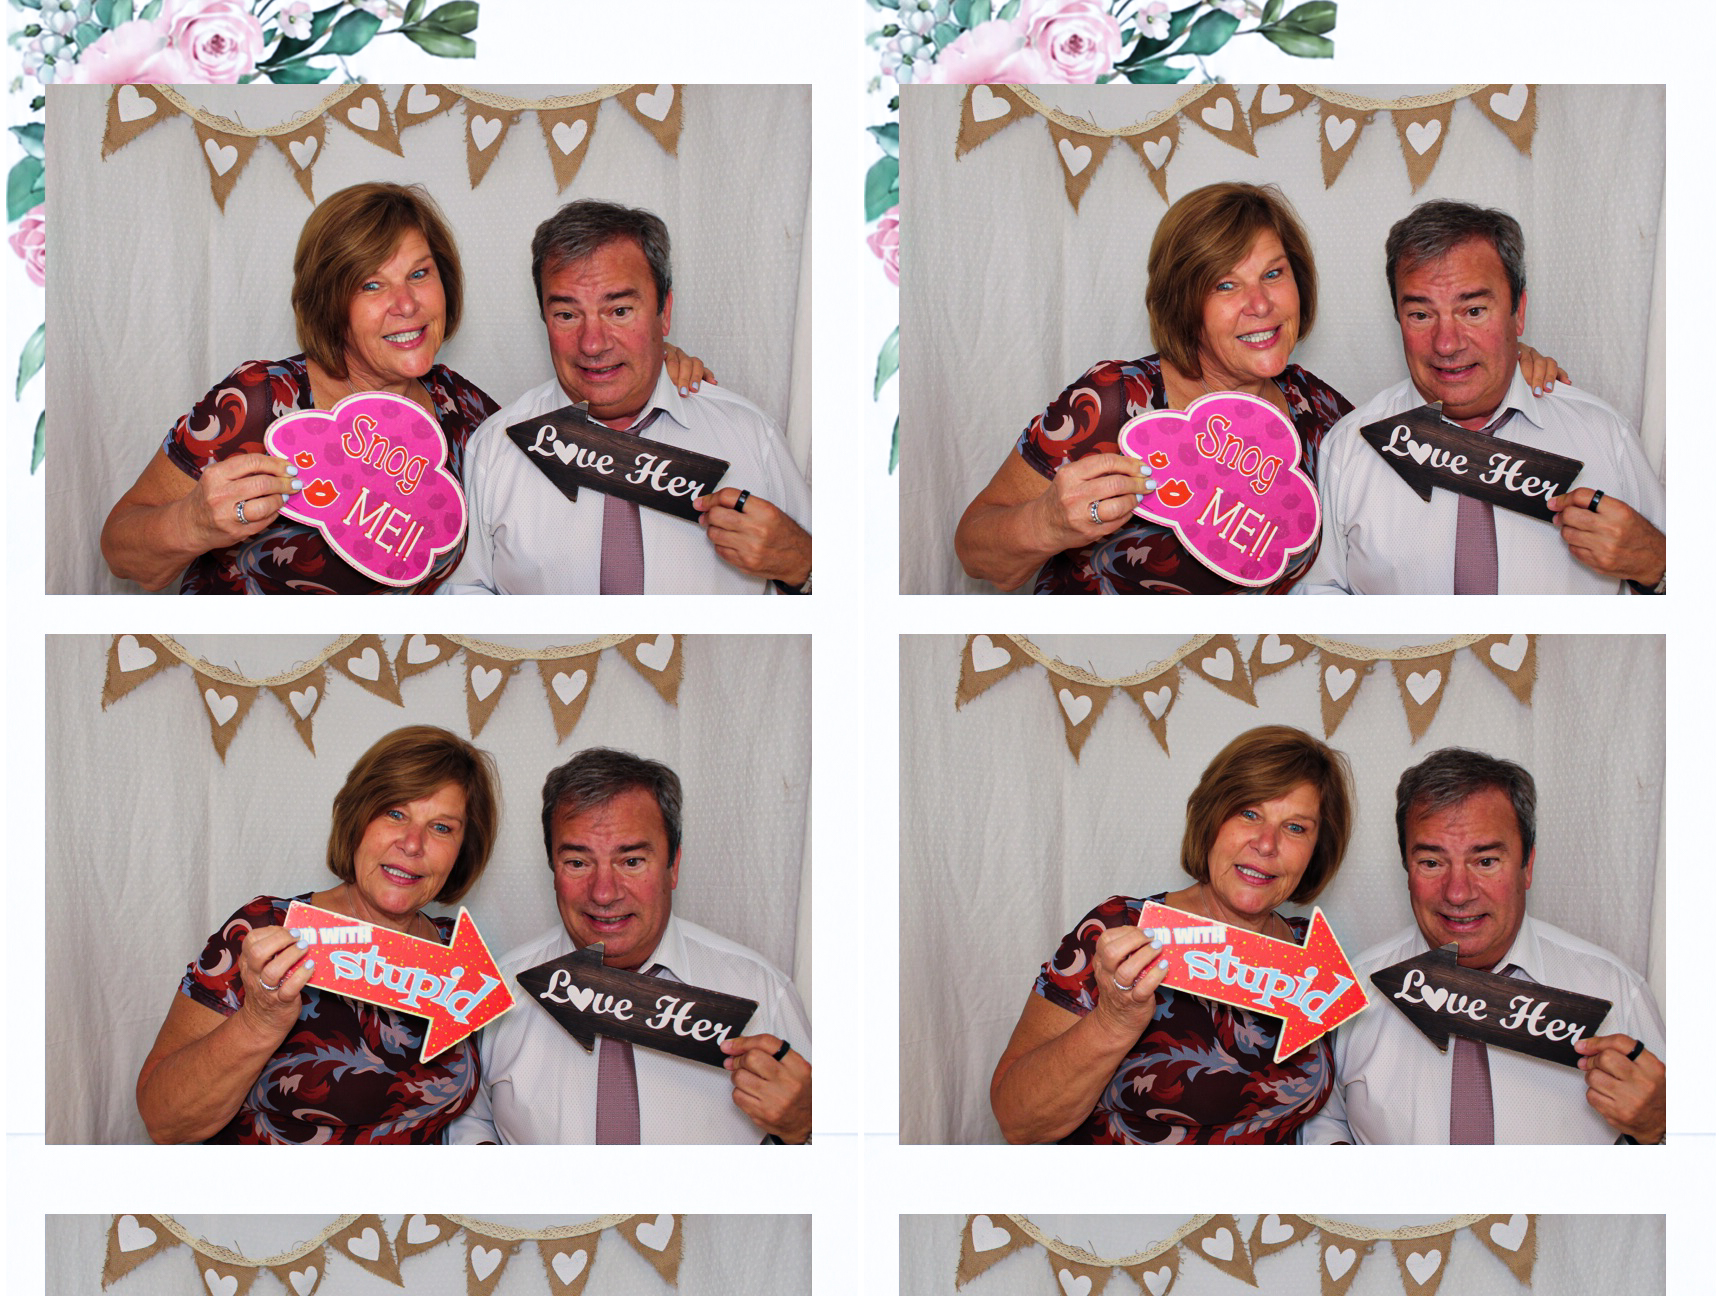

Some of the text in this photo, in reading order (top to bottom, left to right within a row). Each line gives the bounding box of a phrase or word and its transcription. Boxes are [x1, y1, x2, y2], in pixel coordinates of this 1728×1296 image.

[341, 413, 429, 496] Snog
[624, 452, 706, 502] Her
[1195, 413, 1283, 496] Snog
[1478, 452, 1560, 502] Her
[341, 486, 425, 562] ME!!
[1195, 486, 1279, 562] ME!!
[319, 925, 373, 945] WITH
[1173, 925, 1227, 945] WITH
[329, 945, 502, 1025] stupid
[1183, 945, 1356, 1025] stupid
[645, 995, 732, 1047] Her
[1499, 995, 1586, 1047] Her
